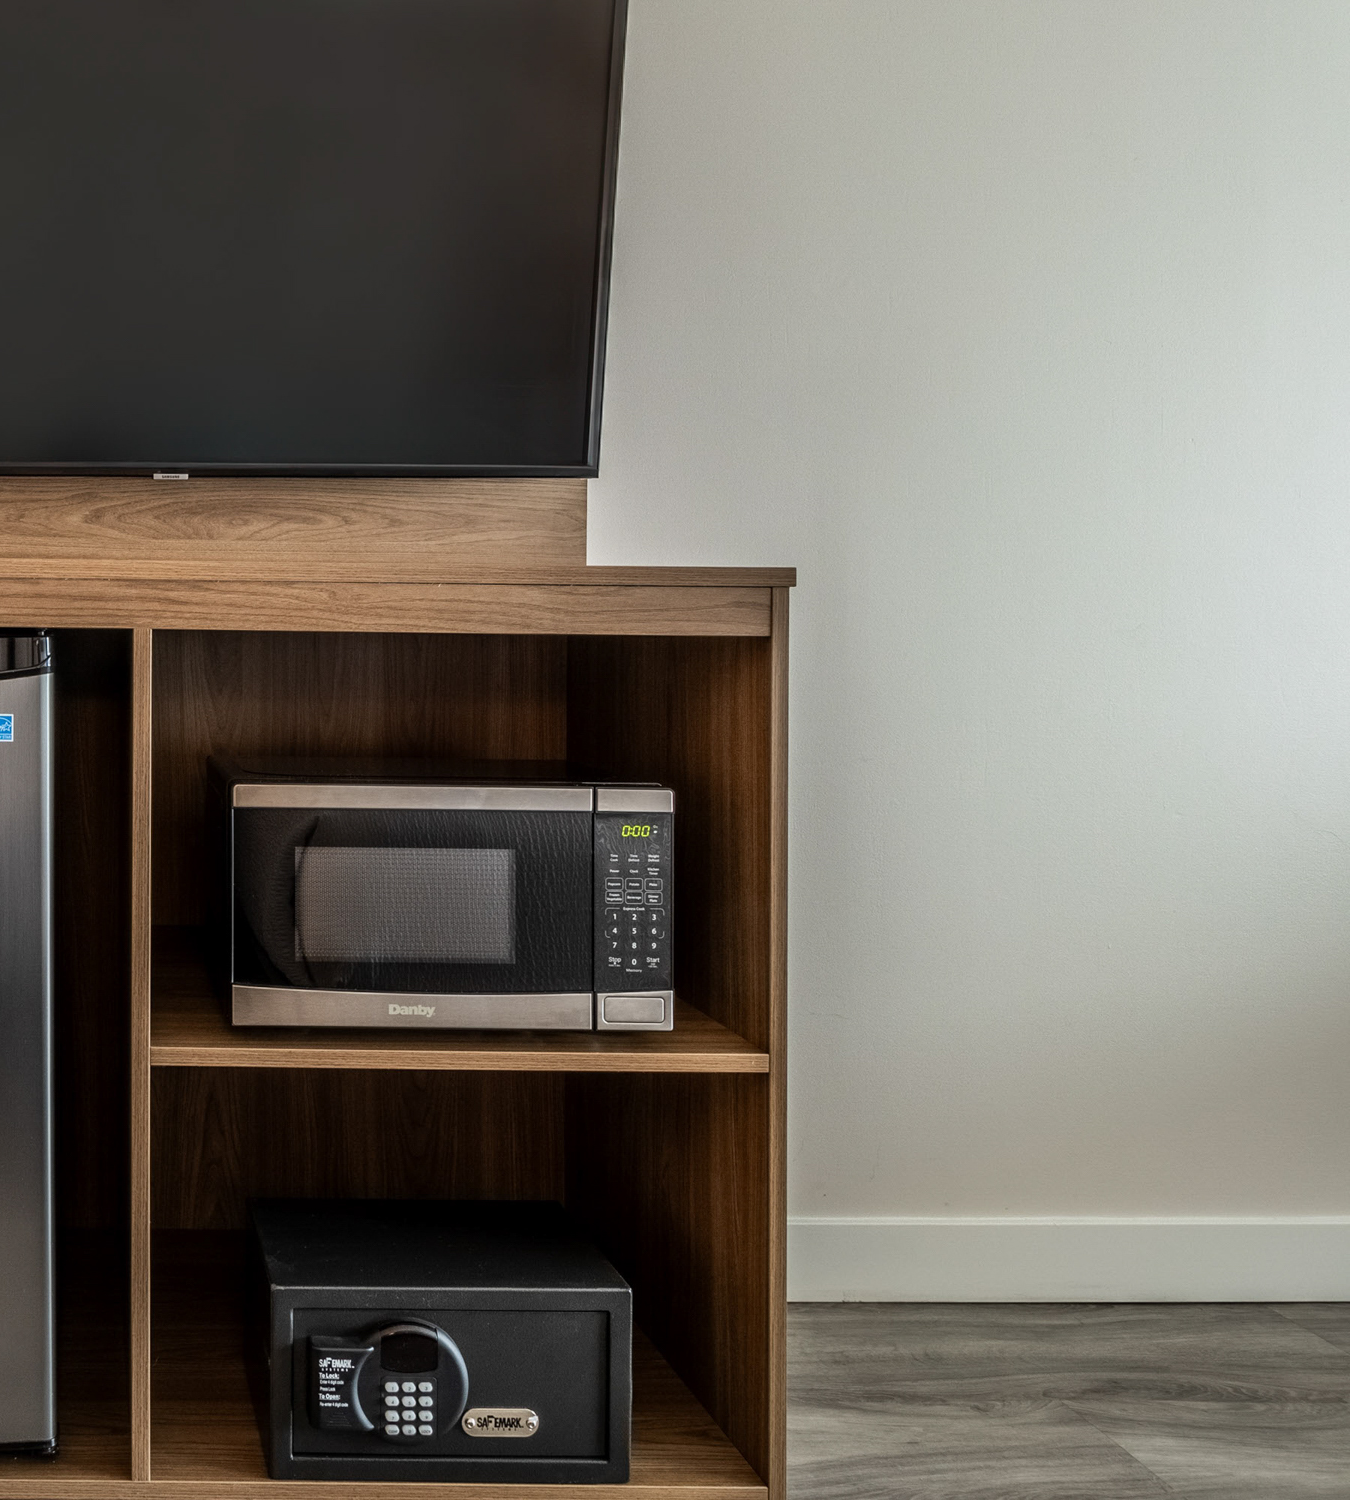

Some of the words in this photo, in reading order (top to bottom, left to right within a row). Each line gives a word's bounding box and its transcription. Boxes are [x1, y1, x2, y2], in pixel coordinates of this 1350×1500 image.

[621, 825, 651, 837] 0:00
[651, 913, 657, 921] 3
[632, 927, 637, 935] 5
[651, 927, 657, 935] 6
[612, 941, 617, 949] 7
[631, 958, 637, 966] 0
[388, 1004, 436, 1017] Danby
[476, 1415, 522, 1428] SAFEMARK
